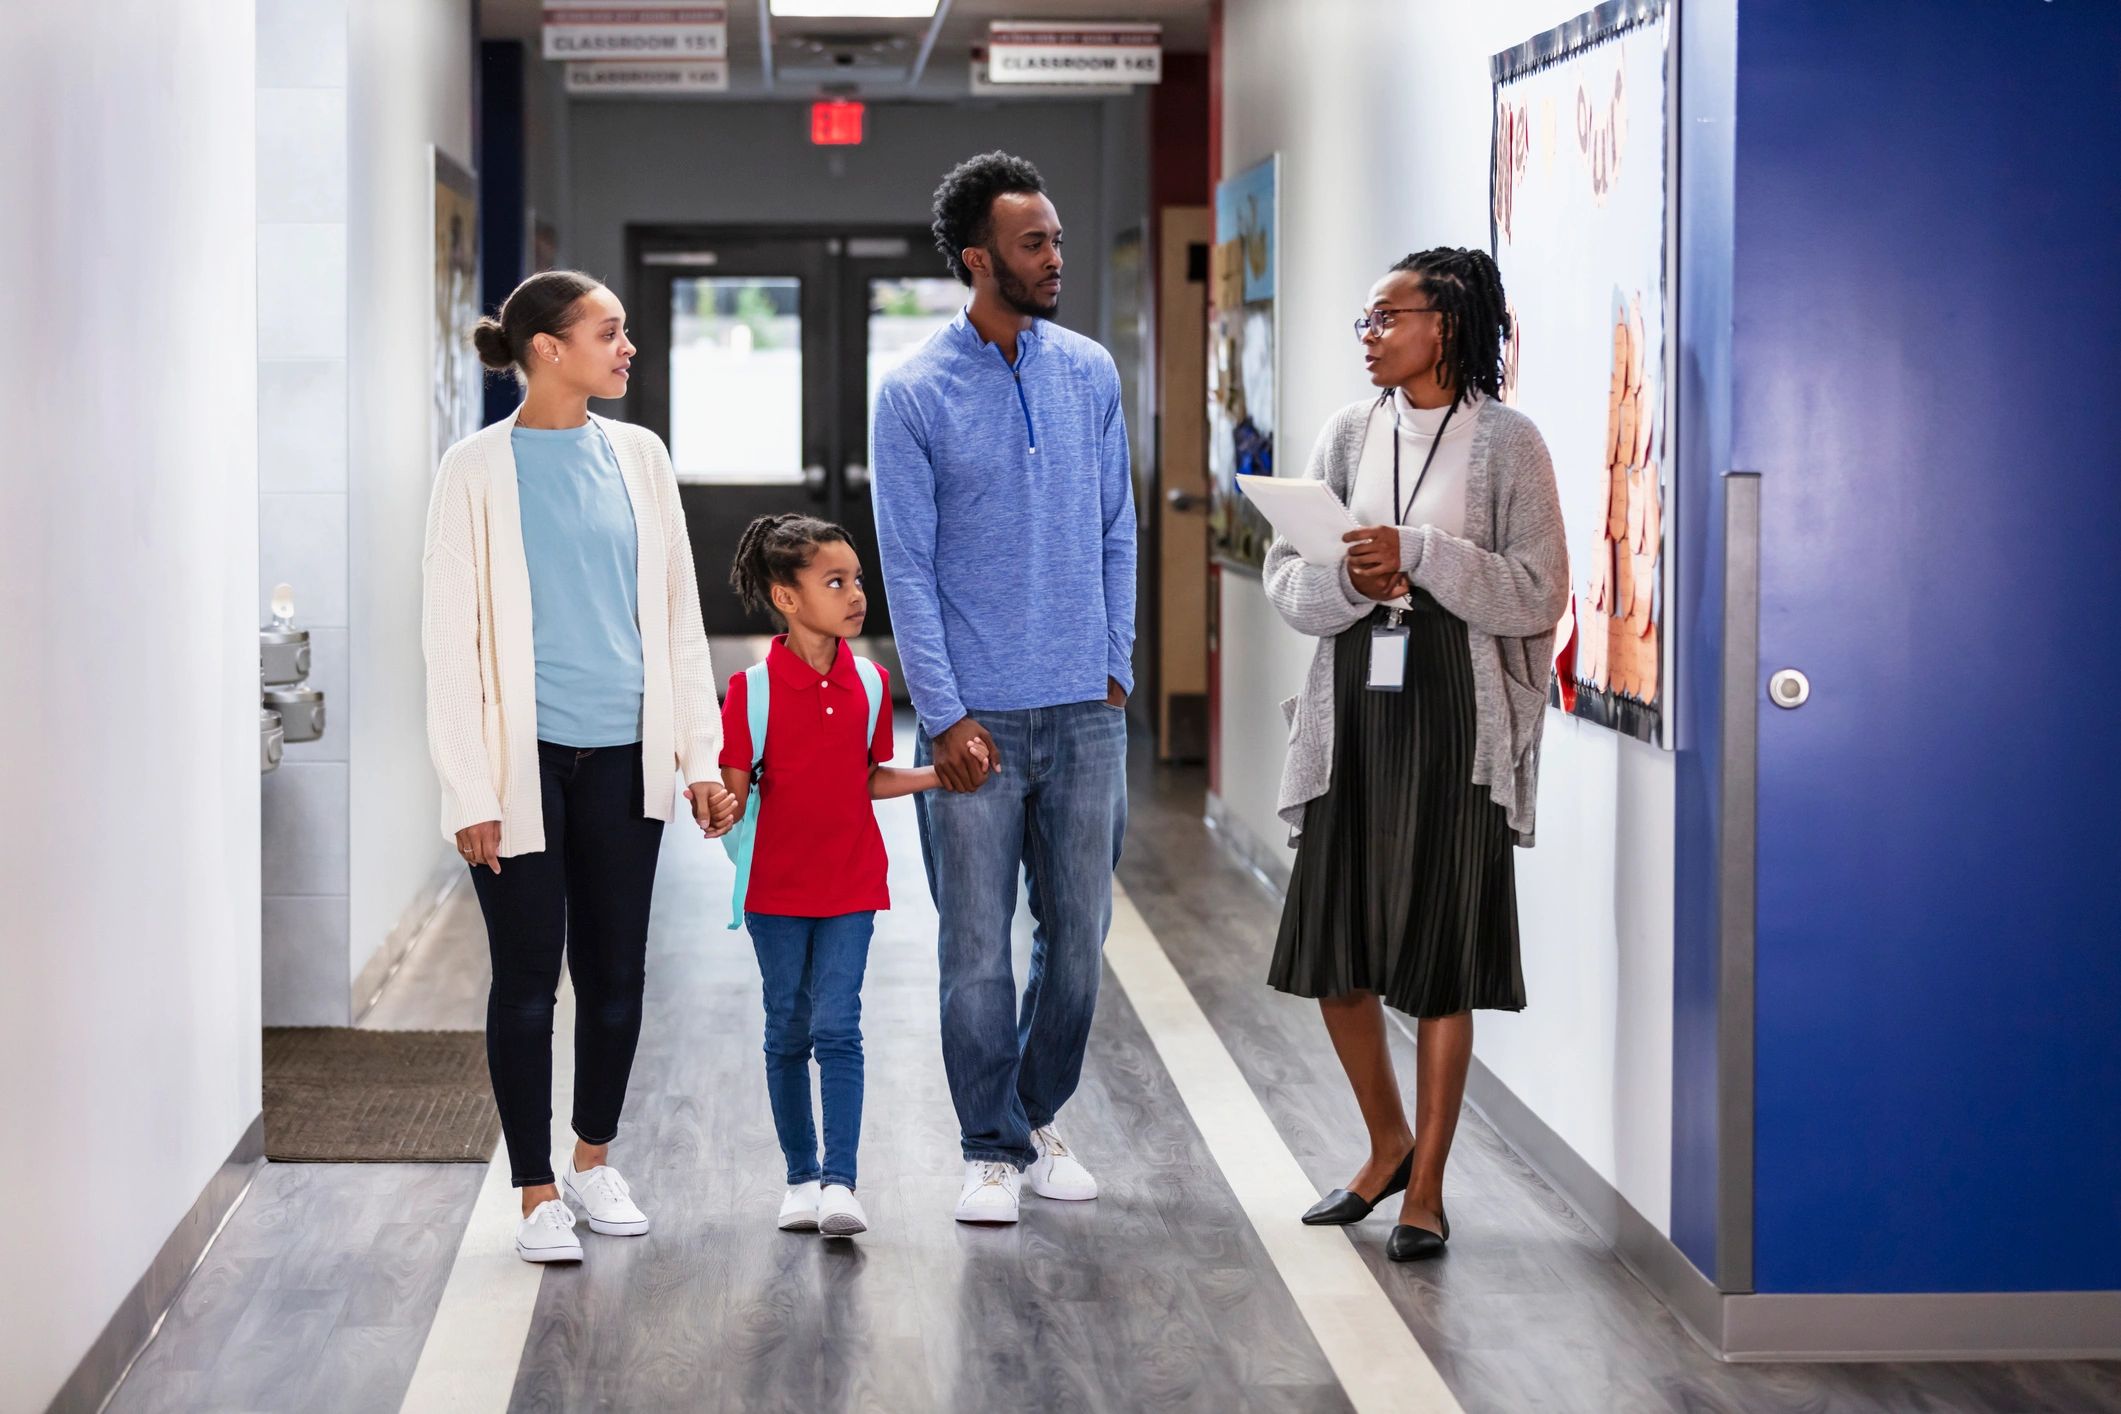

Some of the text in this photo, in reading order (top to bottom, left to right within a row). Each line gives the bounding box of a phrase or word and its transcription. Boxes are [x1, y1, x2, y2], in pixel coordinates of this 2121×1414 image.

[554, 36, 718, 51] CLASSROOM 151
[1002, 56, 1117, 71] CLASSROOM
